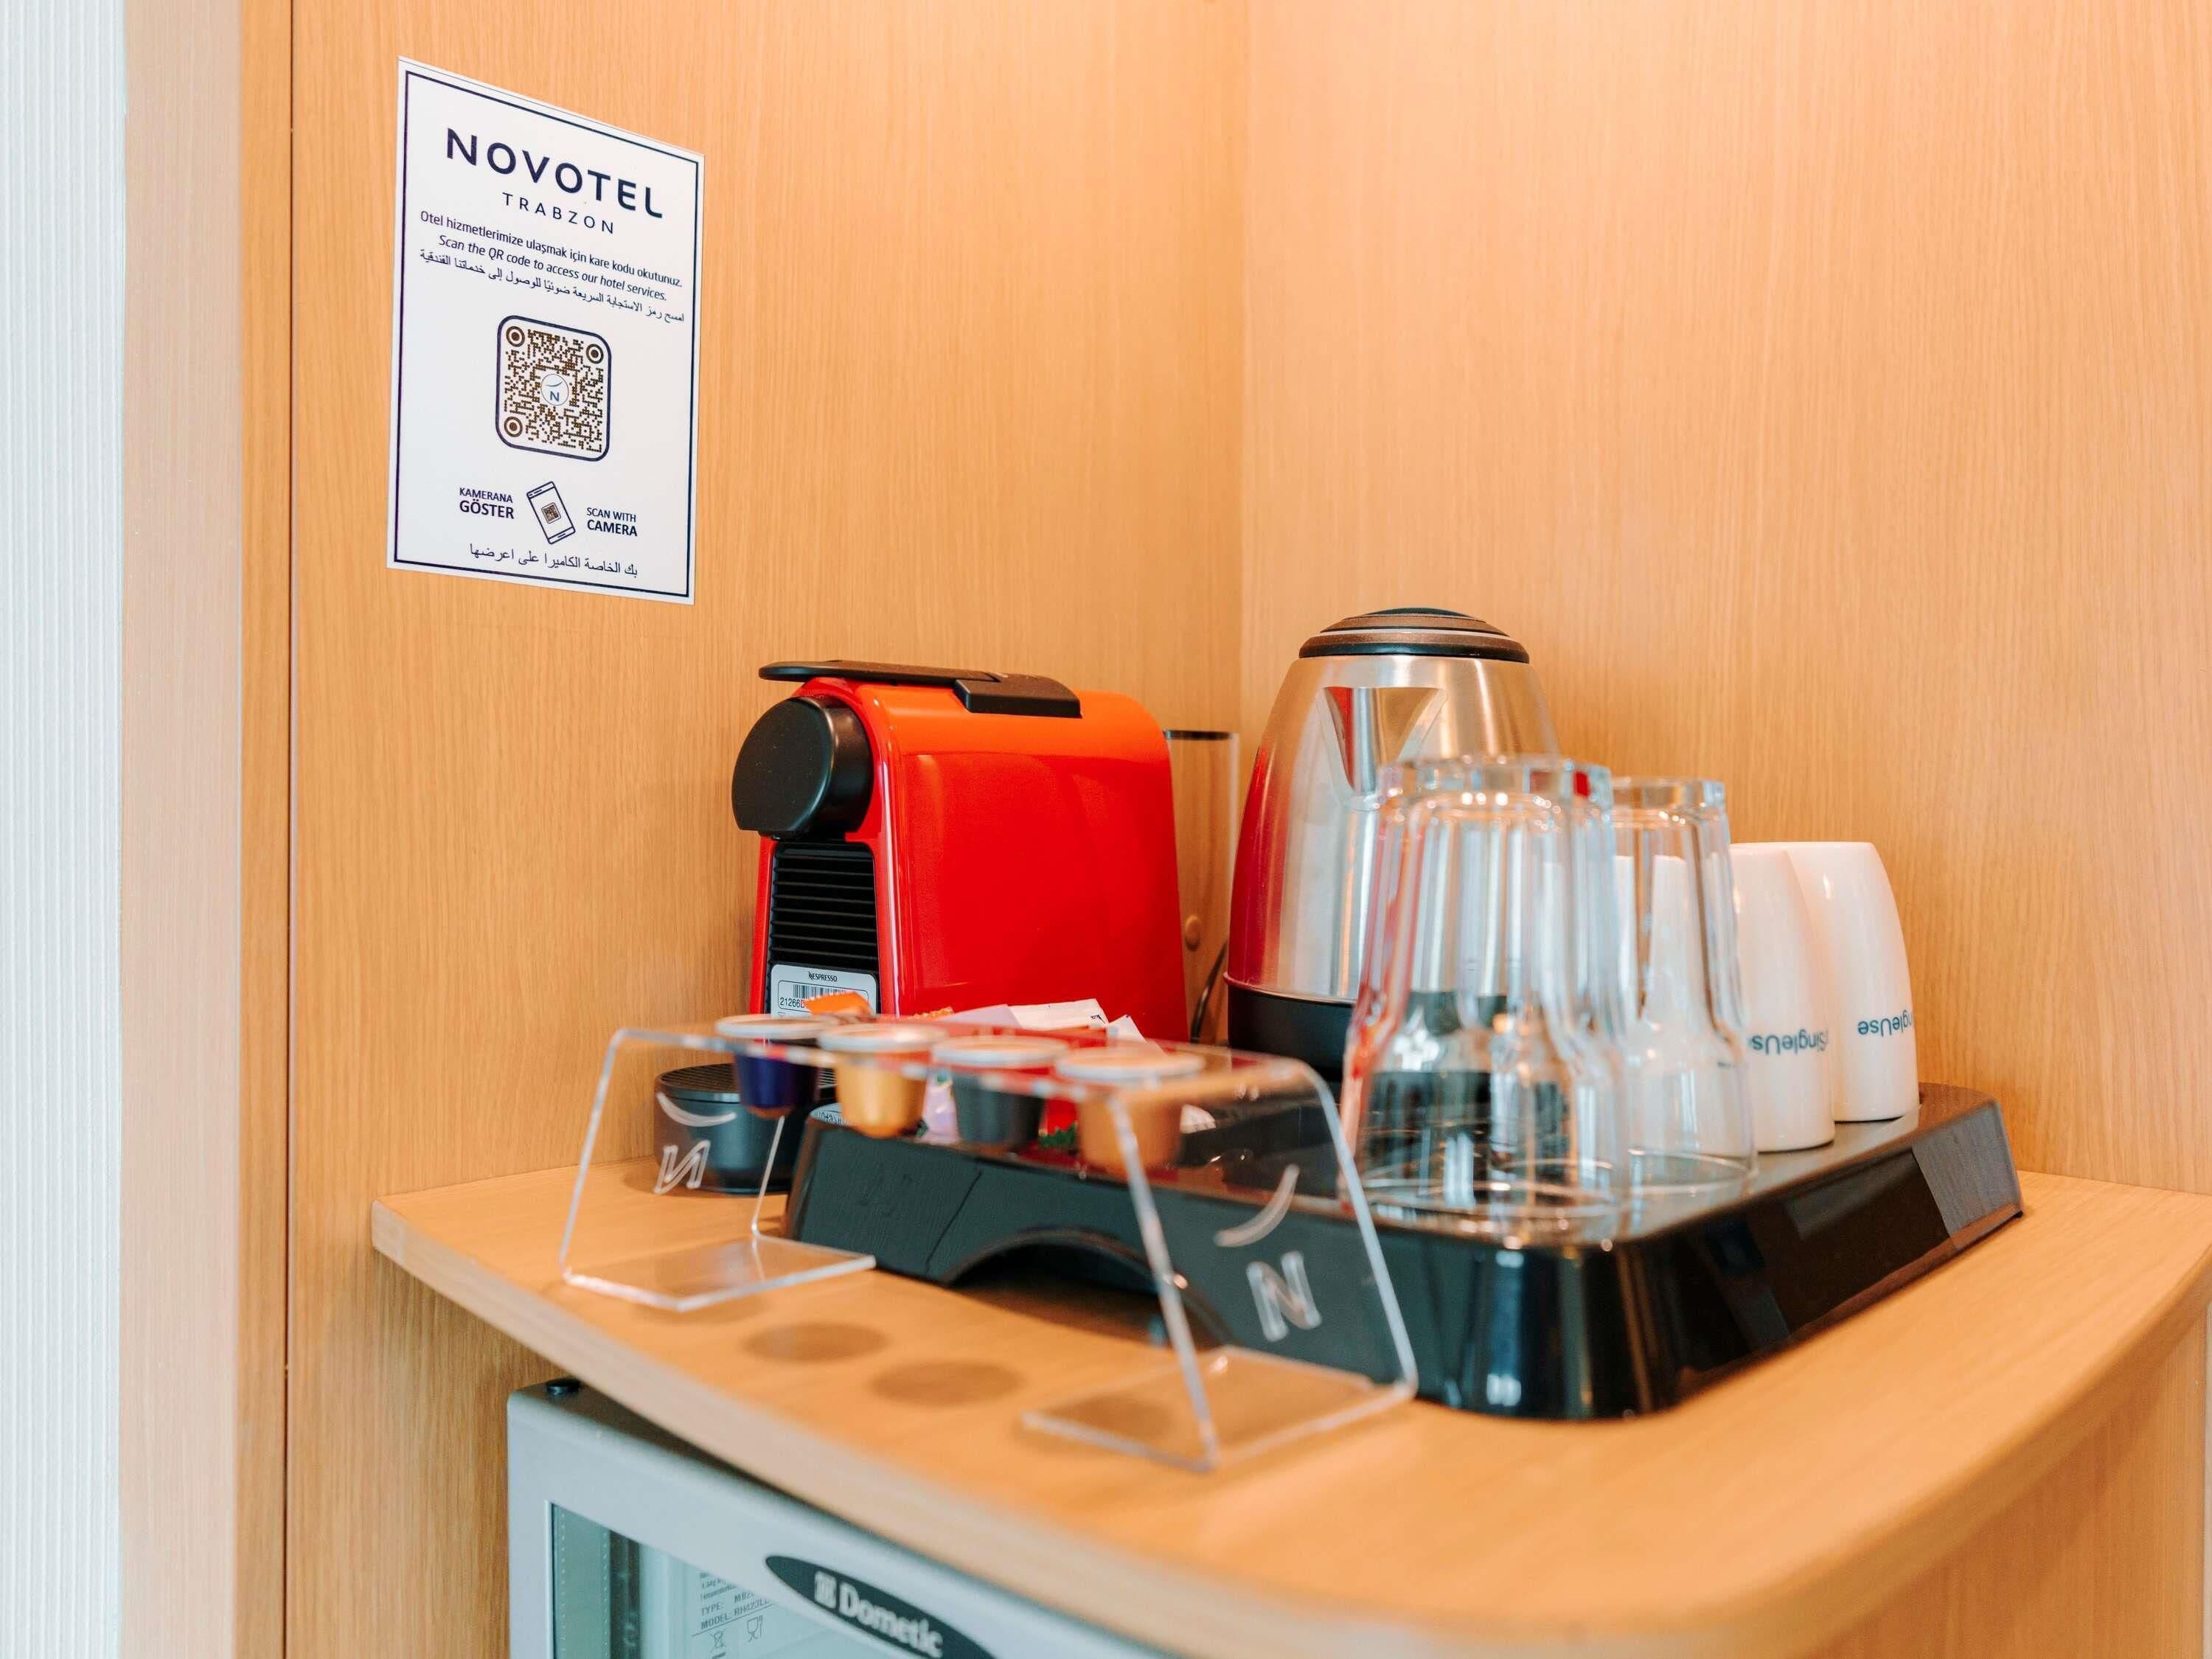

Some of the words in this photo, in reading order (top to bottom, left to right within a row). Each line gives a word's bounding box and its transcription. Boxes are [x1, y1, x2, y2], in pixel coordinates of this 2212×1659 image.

[446, 128, 663, 218] NOVOTEL
[502, 192, 613, 234] TRABZON
[420, 249, 451, 265] الفندقية
[421, 211, 443, 226] Otel
[446, 217, 524, 246] hizmetlerimize
[526, 239, 567, 258] ulaşmak
[570, 248, 587, 262] için
[589, 254, 610, 268] kare
[613, 260, 635, 275] kodu
[637, 268, 683, 287] okutunuz.
[439, 234, 465, 250] Scan
[468, 243, 486, 255] the
[488, 248, 504, 260] QR
[507, 254, 531, 267] code
[534, 260, 543, 270] to
[546, 263, 580, 279] access
[582, 273, 598, 284] our
[600, 276, 625, 291] hotel
[627, 284, 667, 301] services.
[454, 258, 485, 274] خدماتنا
[488, 268, 502, 281] إلى
[506, 271, 541, 289] للوصول
[573, 287, 604, 302] السريعة
[607, 295, 642, 311] الاستجابة
[646, 306, 662, 319] رمز
[549, 390, 560, 402] N
[459, 487, 513, 503] KAMERANA
[459, 499, 514, 519] GÖSTER
[586, 507, 611, 519] SCAN
[612, 511, 636, 523] WITH
[587, 519, 638, 537] CAMERA
[470, 543, 514, 562] اعرضها
[518, 551, 539, 566] على
[544, 553, 580, 568] الكاميرا
[585, 557, 621, 574] الخاصة
[625, 564, 638, 578] بك
[807, 971, 838, 982] NESPRESSO
[1245, 1251, 1322, 1341] N
[839, 1582, 943, 1658] Dometic
